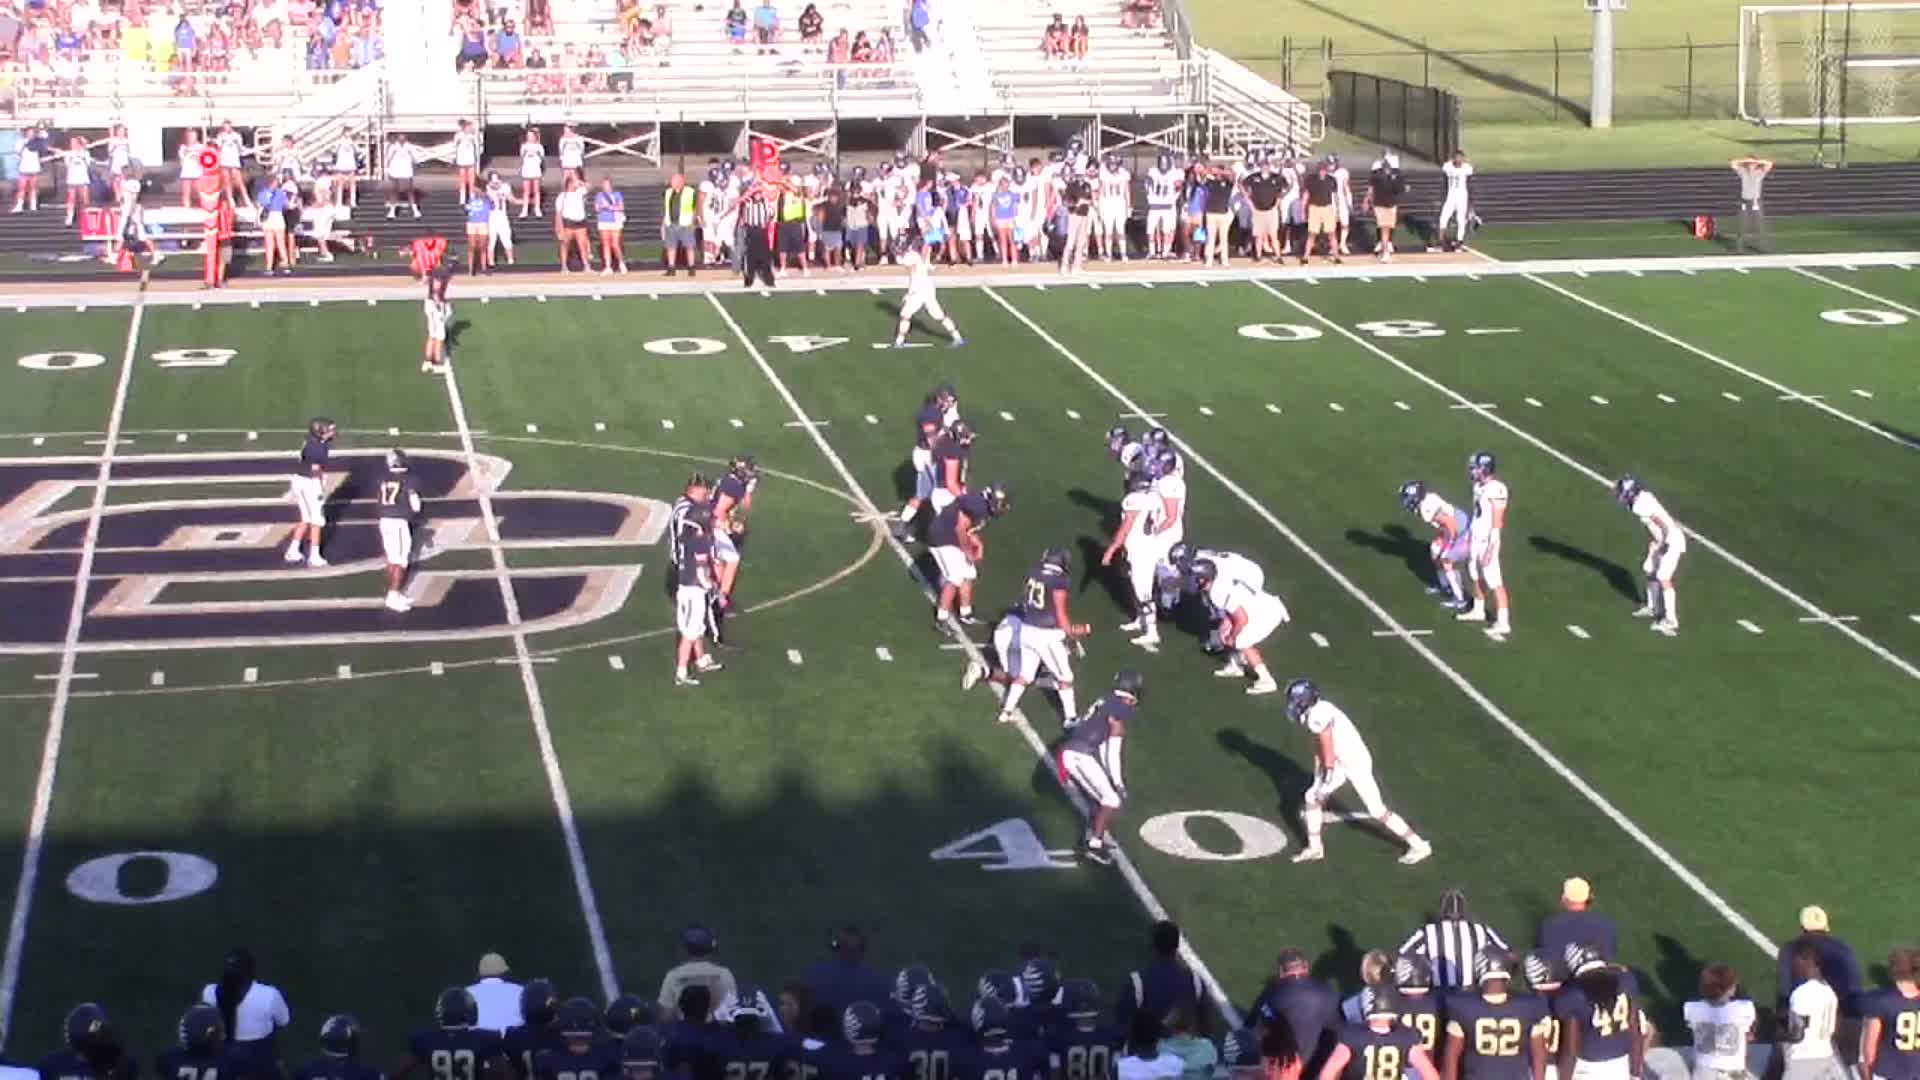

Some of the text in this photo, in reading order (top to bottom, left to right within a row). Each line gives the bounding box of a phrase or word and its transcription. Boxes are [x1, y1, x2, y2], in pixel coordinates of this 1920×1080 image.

[380, 481, 401, 506] 17
[1592, 992, 1630, 1036] 44
[1475, 1017, 1521, 1056] 62
[431, 1049, 475, 1080] 93
[909, 1050, 949, 1080] 30
[1067, 1045, 1110, 1080] 80
[1364, 1045, 1400, 1080] 18
